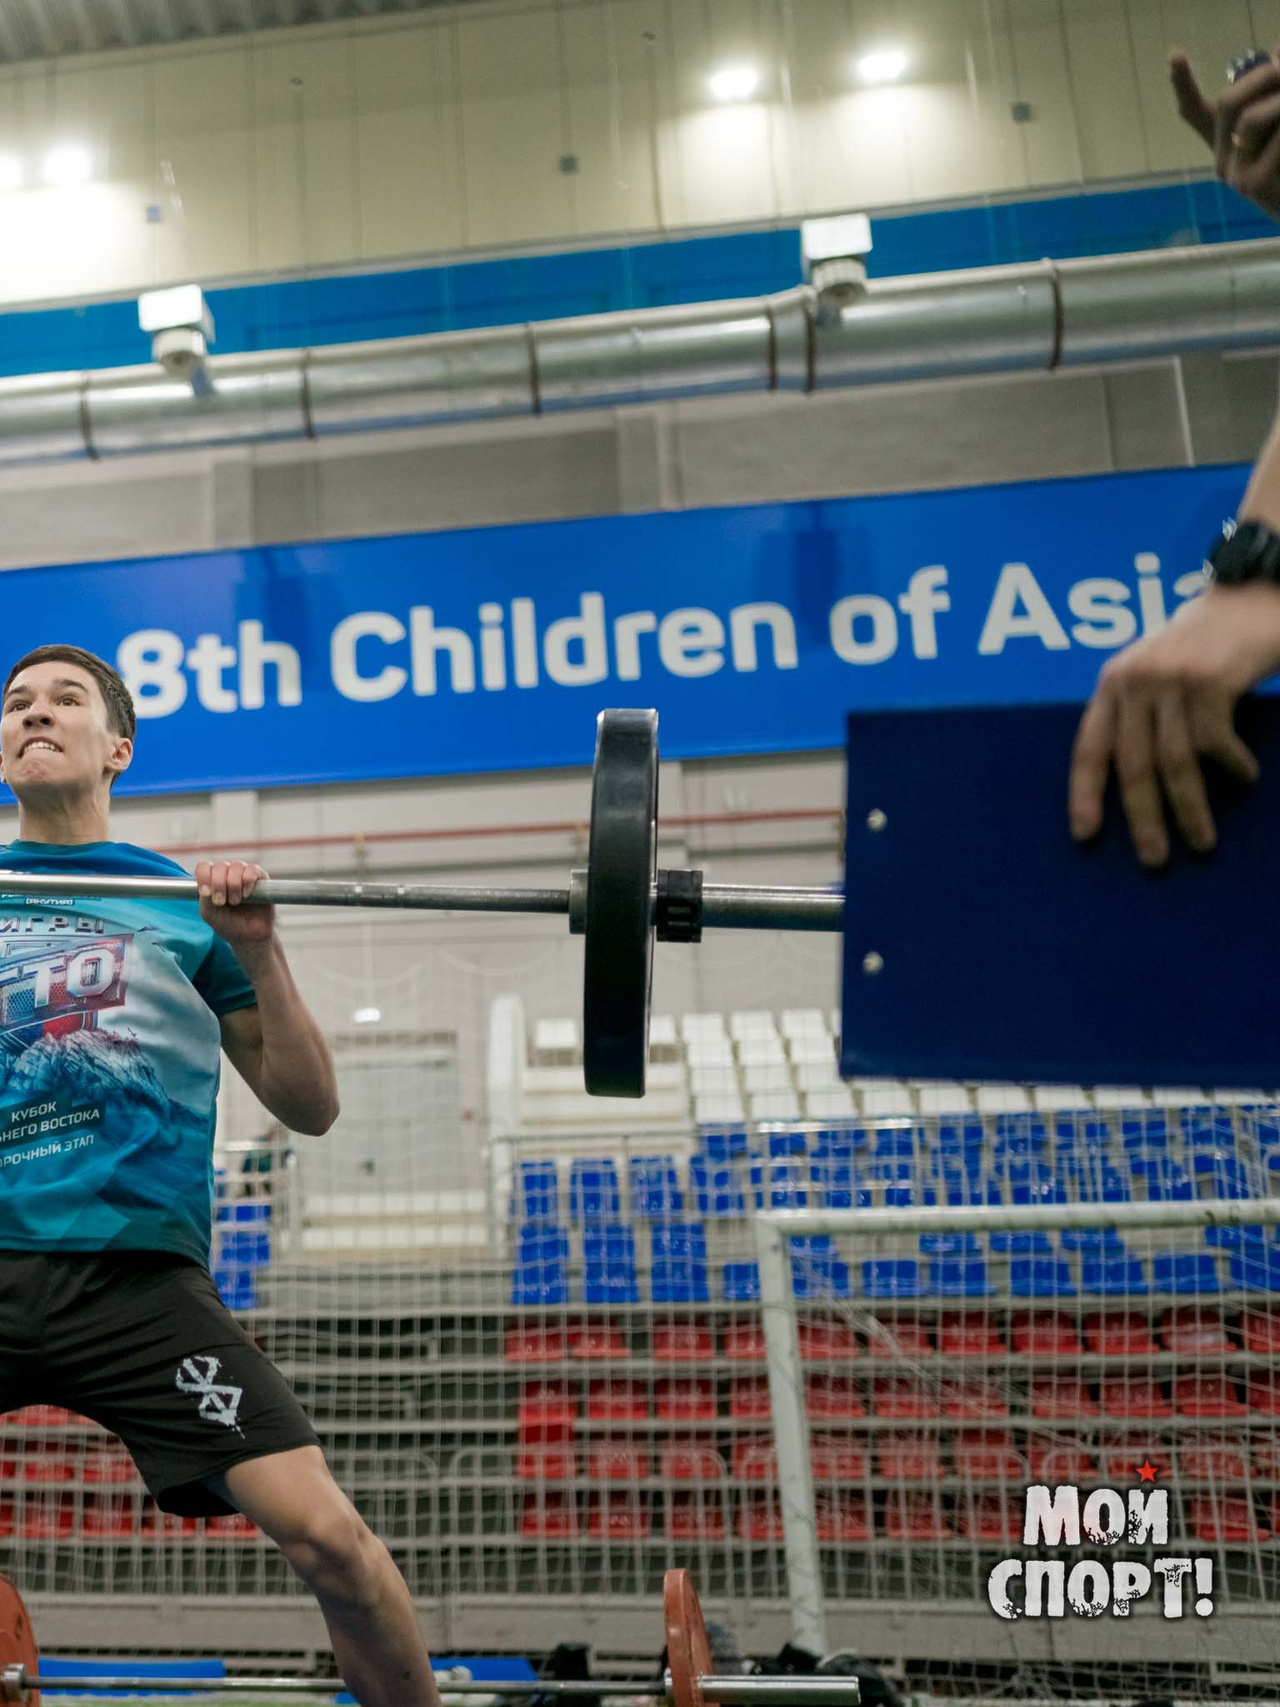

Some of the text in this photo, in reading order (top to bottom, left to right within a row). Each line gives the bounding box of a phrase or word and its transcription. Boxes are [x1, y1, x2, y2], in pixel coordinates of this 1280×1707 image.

[117, 618, 303, 719] 8th
[330, 592, 799, 702] Children
[829, 565, 951, 664] of
[11, 1101, 57, 1123] КУБОК
[40, 1109, 100, 1132] ВОСТОКА
[64, 1134, 94, 1151] ЭТАП
